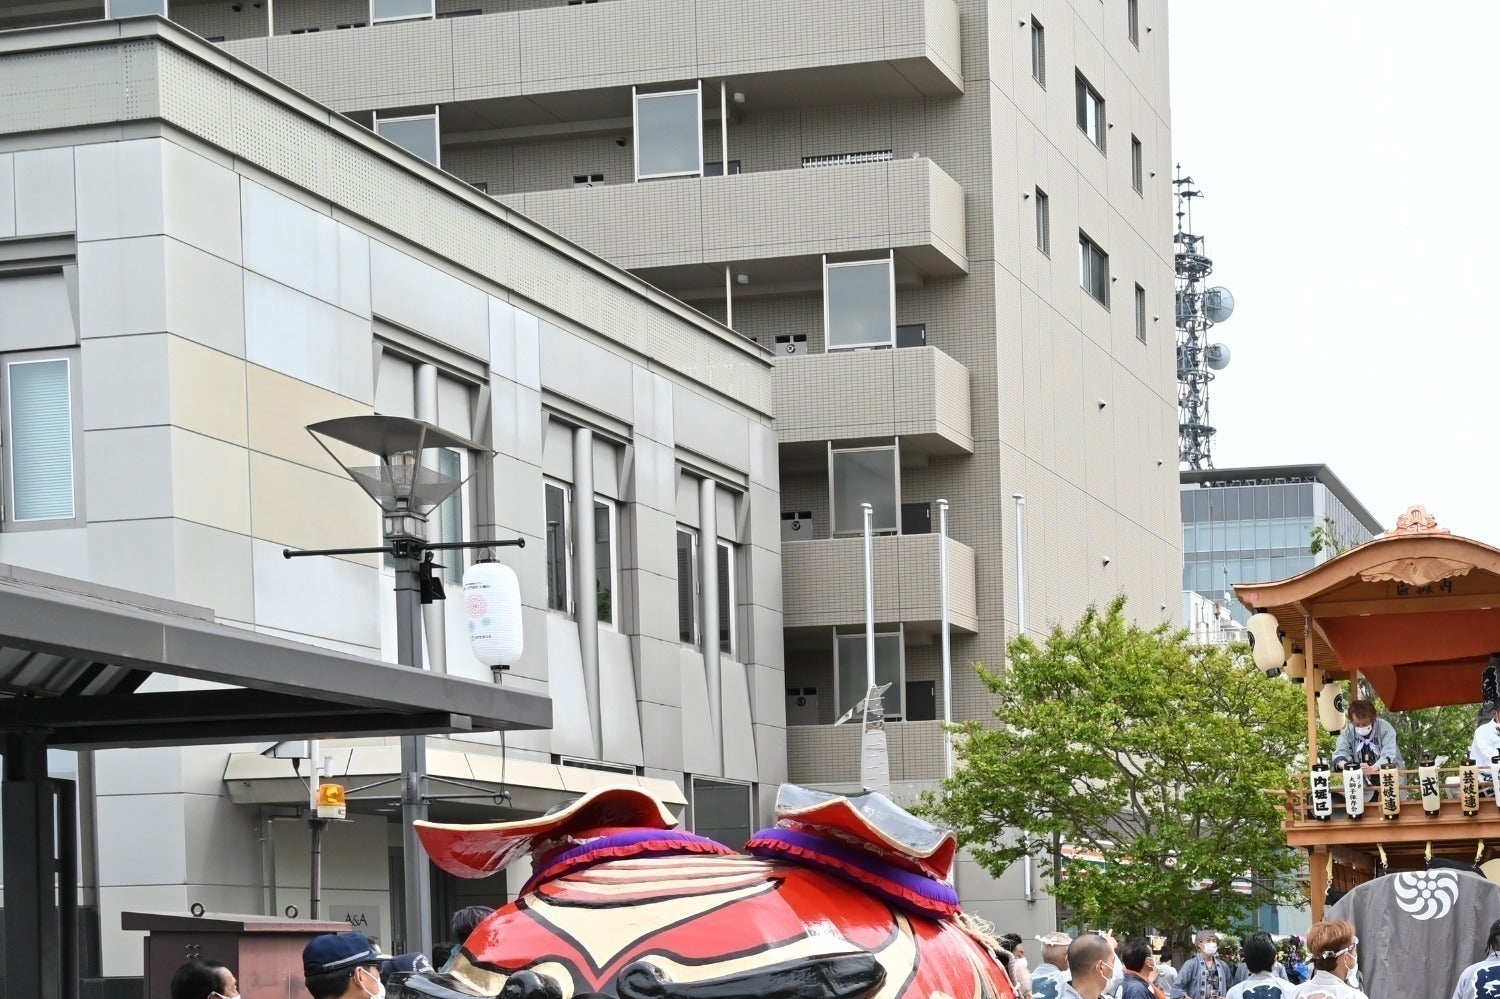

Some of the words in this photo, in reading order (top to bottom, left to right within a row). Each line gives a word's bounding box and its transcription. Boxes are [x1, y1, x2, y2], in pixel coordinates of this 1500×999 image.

[1314, 775, 1329, 811] 内堀区
[1421, 776, 1438, 797] 武
[345, 913, 368, 927] A&A
